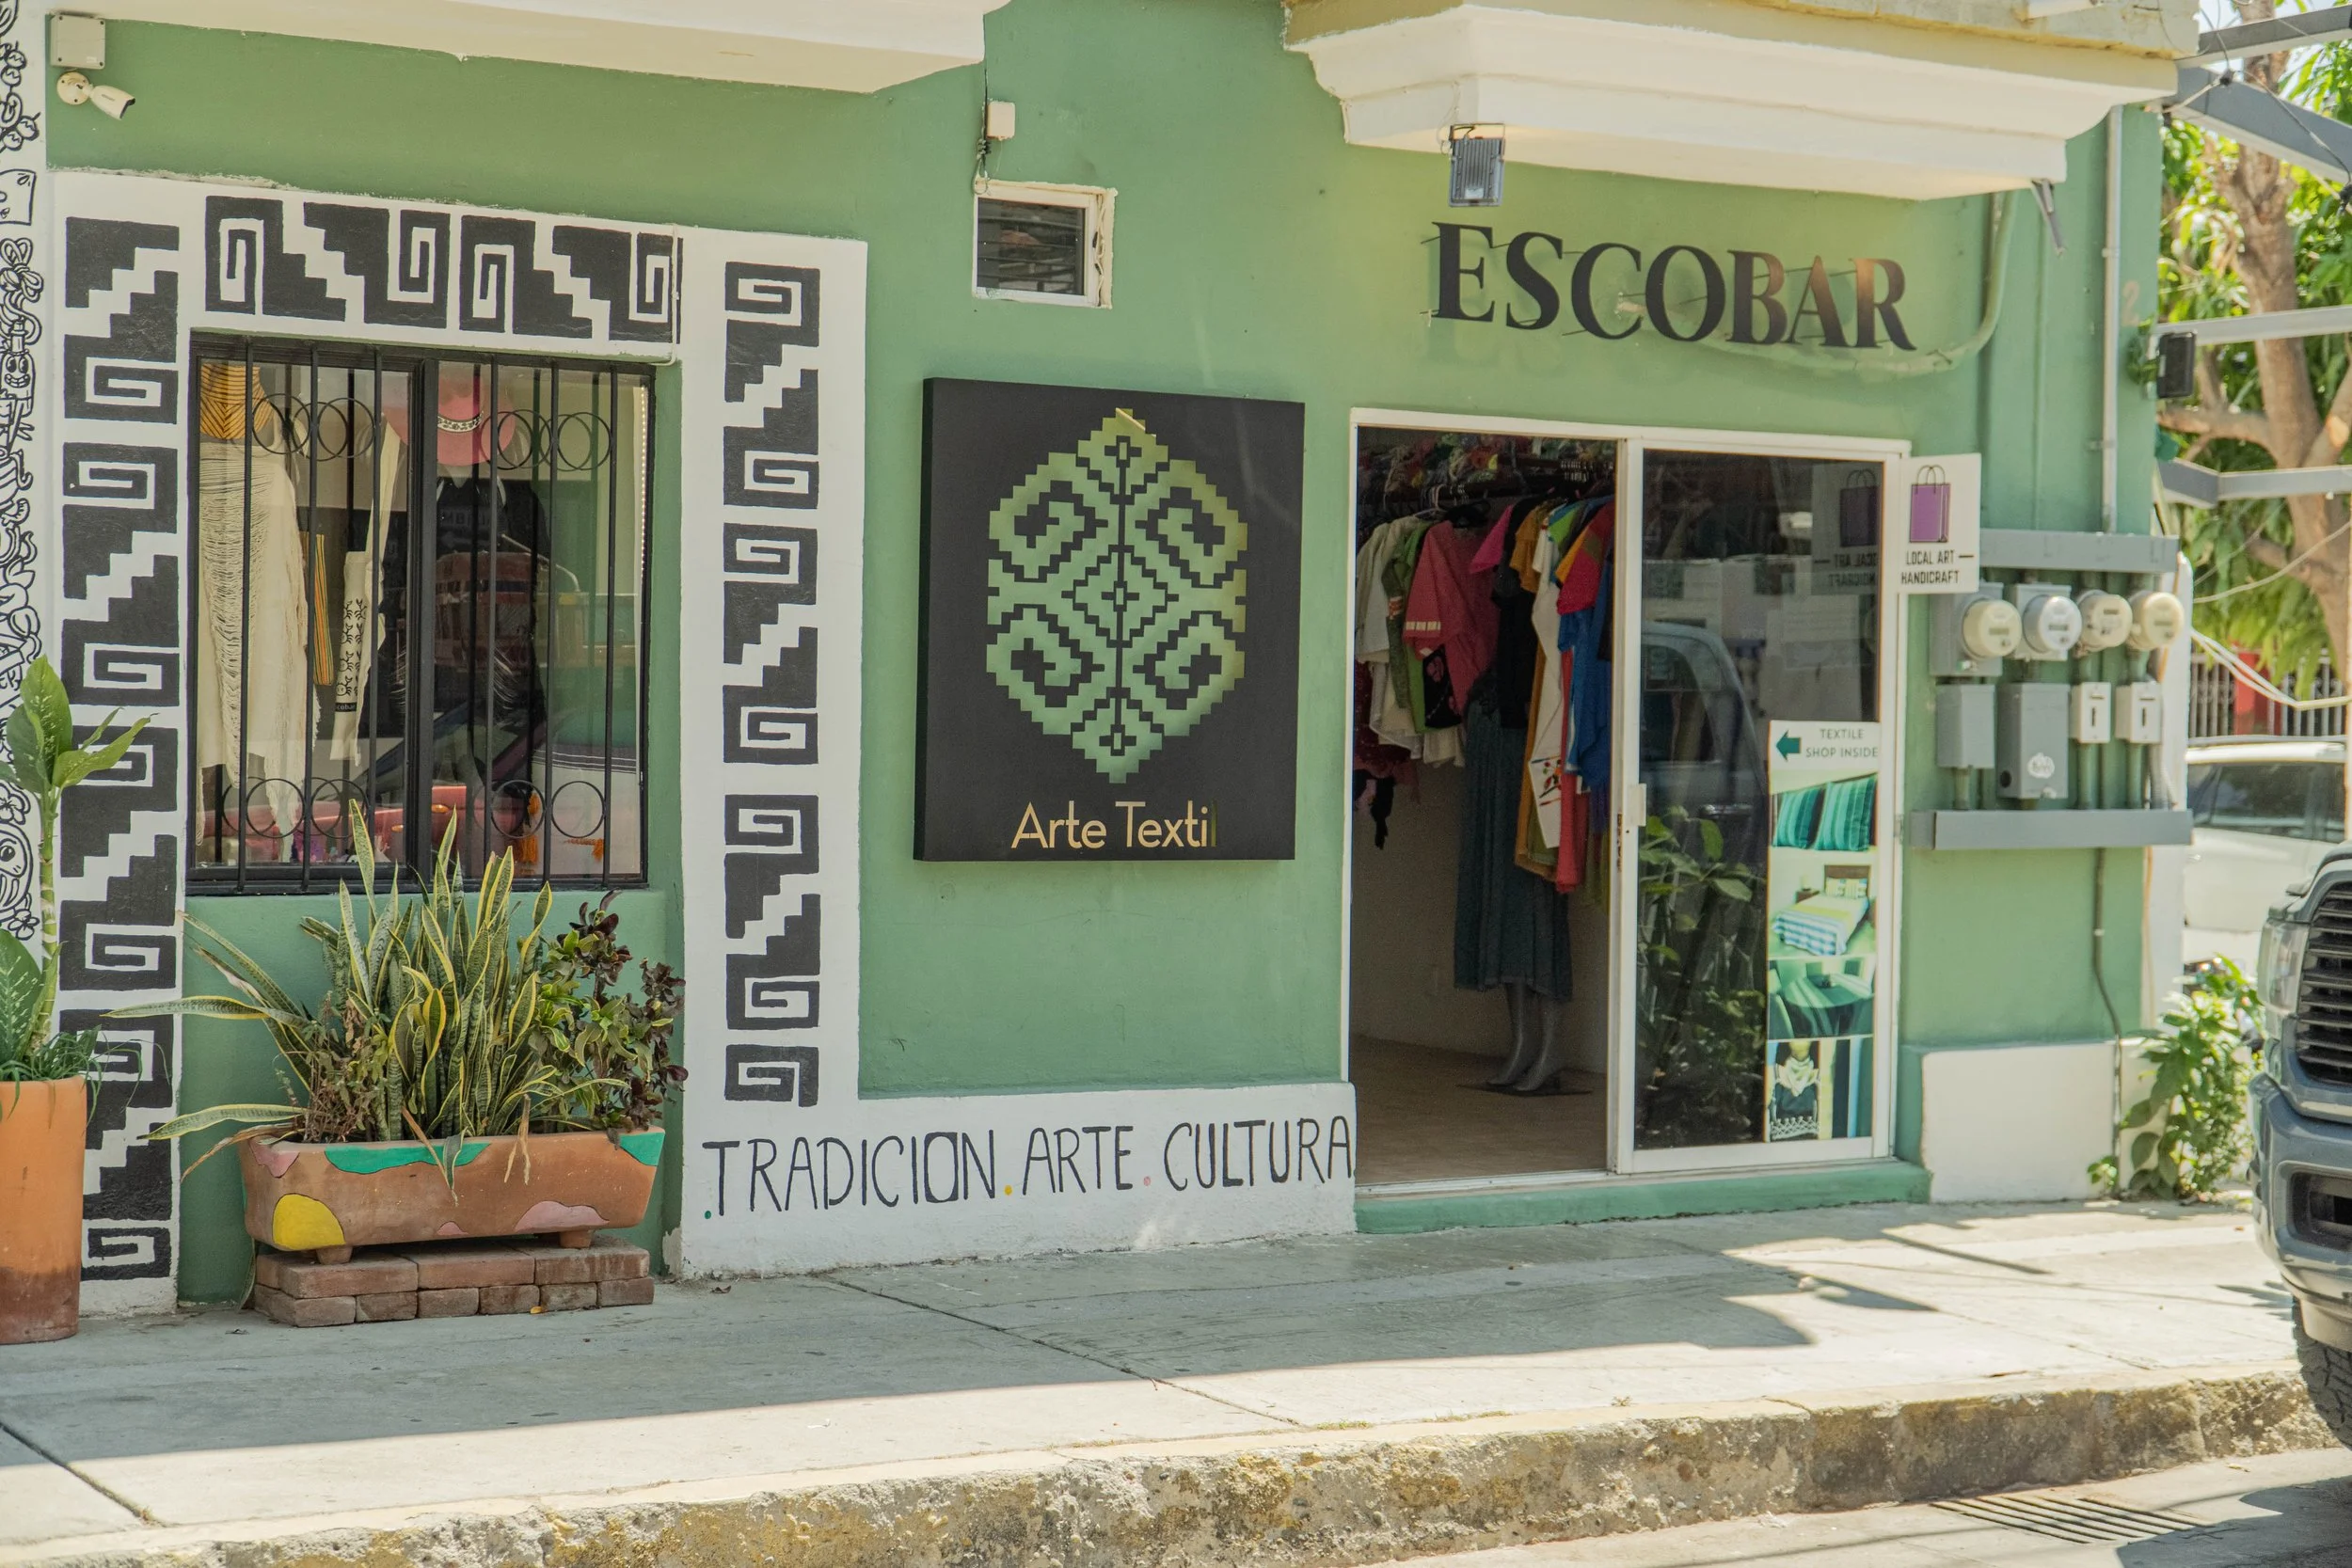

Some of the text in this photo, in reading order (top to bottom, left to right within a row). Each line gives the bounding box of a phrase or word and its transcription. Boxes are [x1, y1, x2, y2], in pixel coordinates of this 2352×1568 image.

[1432, 221, 1917, 351] ESCOBAR
[1906, 549, 1955, 565] LOCAL ART
[1900, 571, 1960, 585] HANDICRAFT
[1820, 728, 1865, 739] TEXTILE
[1805, 747, 1879, 758] SHOP INSIDE
[1010, 800, 1107, 849] Arte
[1164, 1115, 1353, 1192] CULTURA
